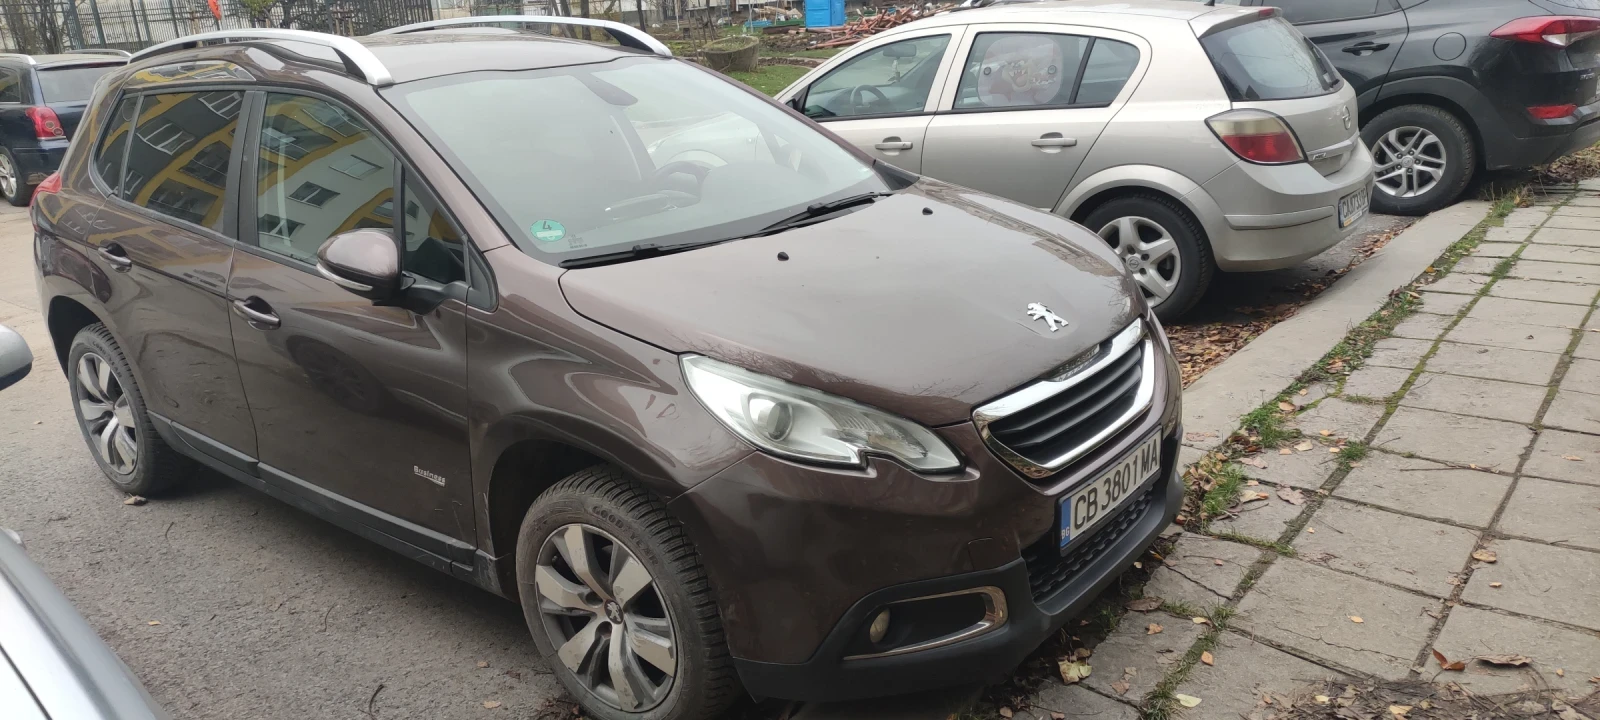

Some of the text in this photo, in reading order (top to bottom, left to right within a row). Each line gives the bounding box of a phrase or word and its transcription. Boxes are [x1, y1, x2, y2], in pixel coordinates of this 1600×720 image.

[542, 221, 552, 230] 4
[413, 465, 446, 483] Business
[1074, 439, 1158, 530] CB 3801 MA
[1061, 526, 1070, 540] BG
